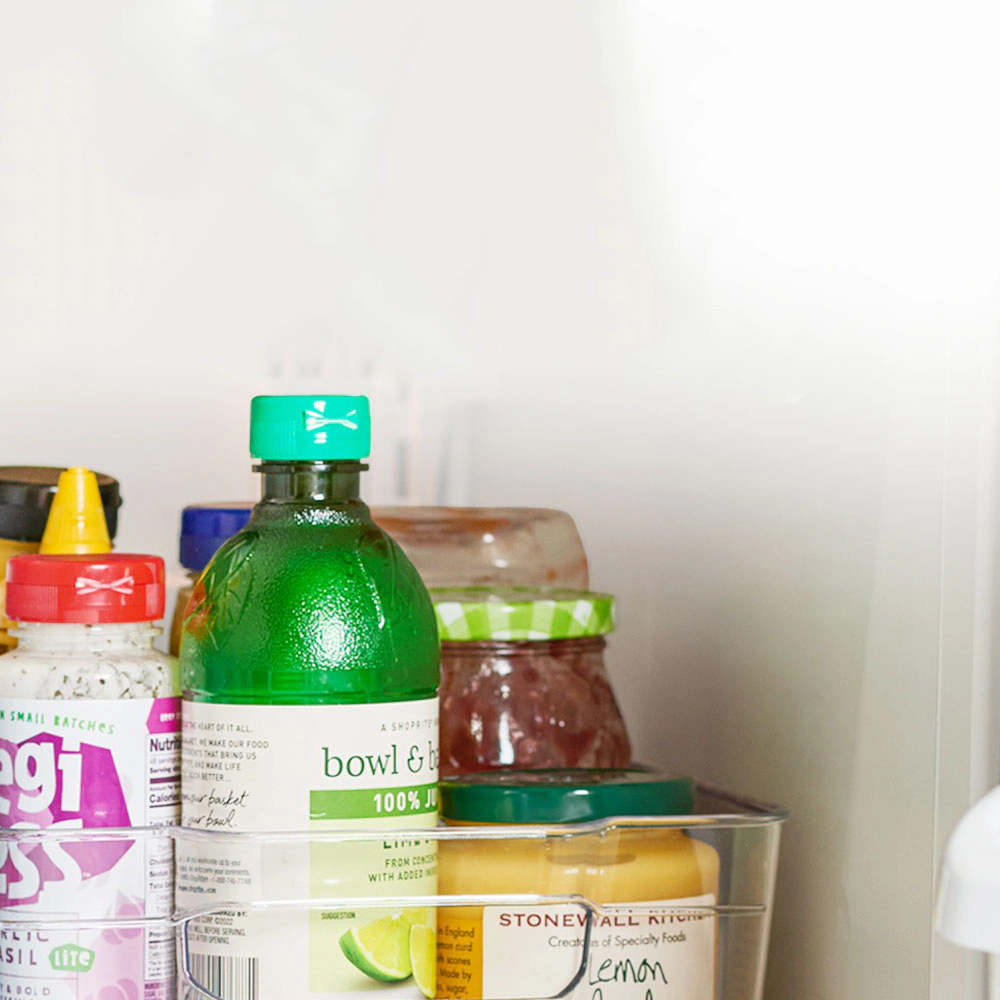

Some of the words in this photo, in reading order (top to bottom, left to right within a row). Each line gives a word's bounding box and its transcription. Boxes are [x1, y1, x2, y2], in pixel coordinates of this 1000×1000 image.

[10, 710, 45, 725] SMALL
[216, 723, 225, 731] OF
[226, 724, 234, 732] IT
[209, 738, 226, 747] MAKE
[228, 739, 244, 748] OUR
[246, 740, 269, 749] FOOD
[220, 750, 244, 760] BRING
[245, 752, 257, 760] US
[321, 744, 399, 778] bowl
[407, 745, 424, 774] &
[224, 762, 241, 771] LIFE
[207, 788, 250, 808] basket
[373, 790, 421, 813] 100%
[385, 856, 411, 869] FROM
[368, 871, 395, 883] WITH
[397, 869, 423, 881] ADDED
[320, 911, 356, 921] SUGGESTION
[445, 926, 475, 940] England
[602, 935, 612, 947] of
[614, 933, 660, 949] Specialty
[662, 931, 687, 944] Foods
[455, 942, 473, 952] curd
[446, 957, 471, 966] scones
[588, 952, 668, 985] Lemon
[462, 970, 472, 982] by
[16, 985, 51, 996] BOLD
[446, 985, 469, 997] sugar,
